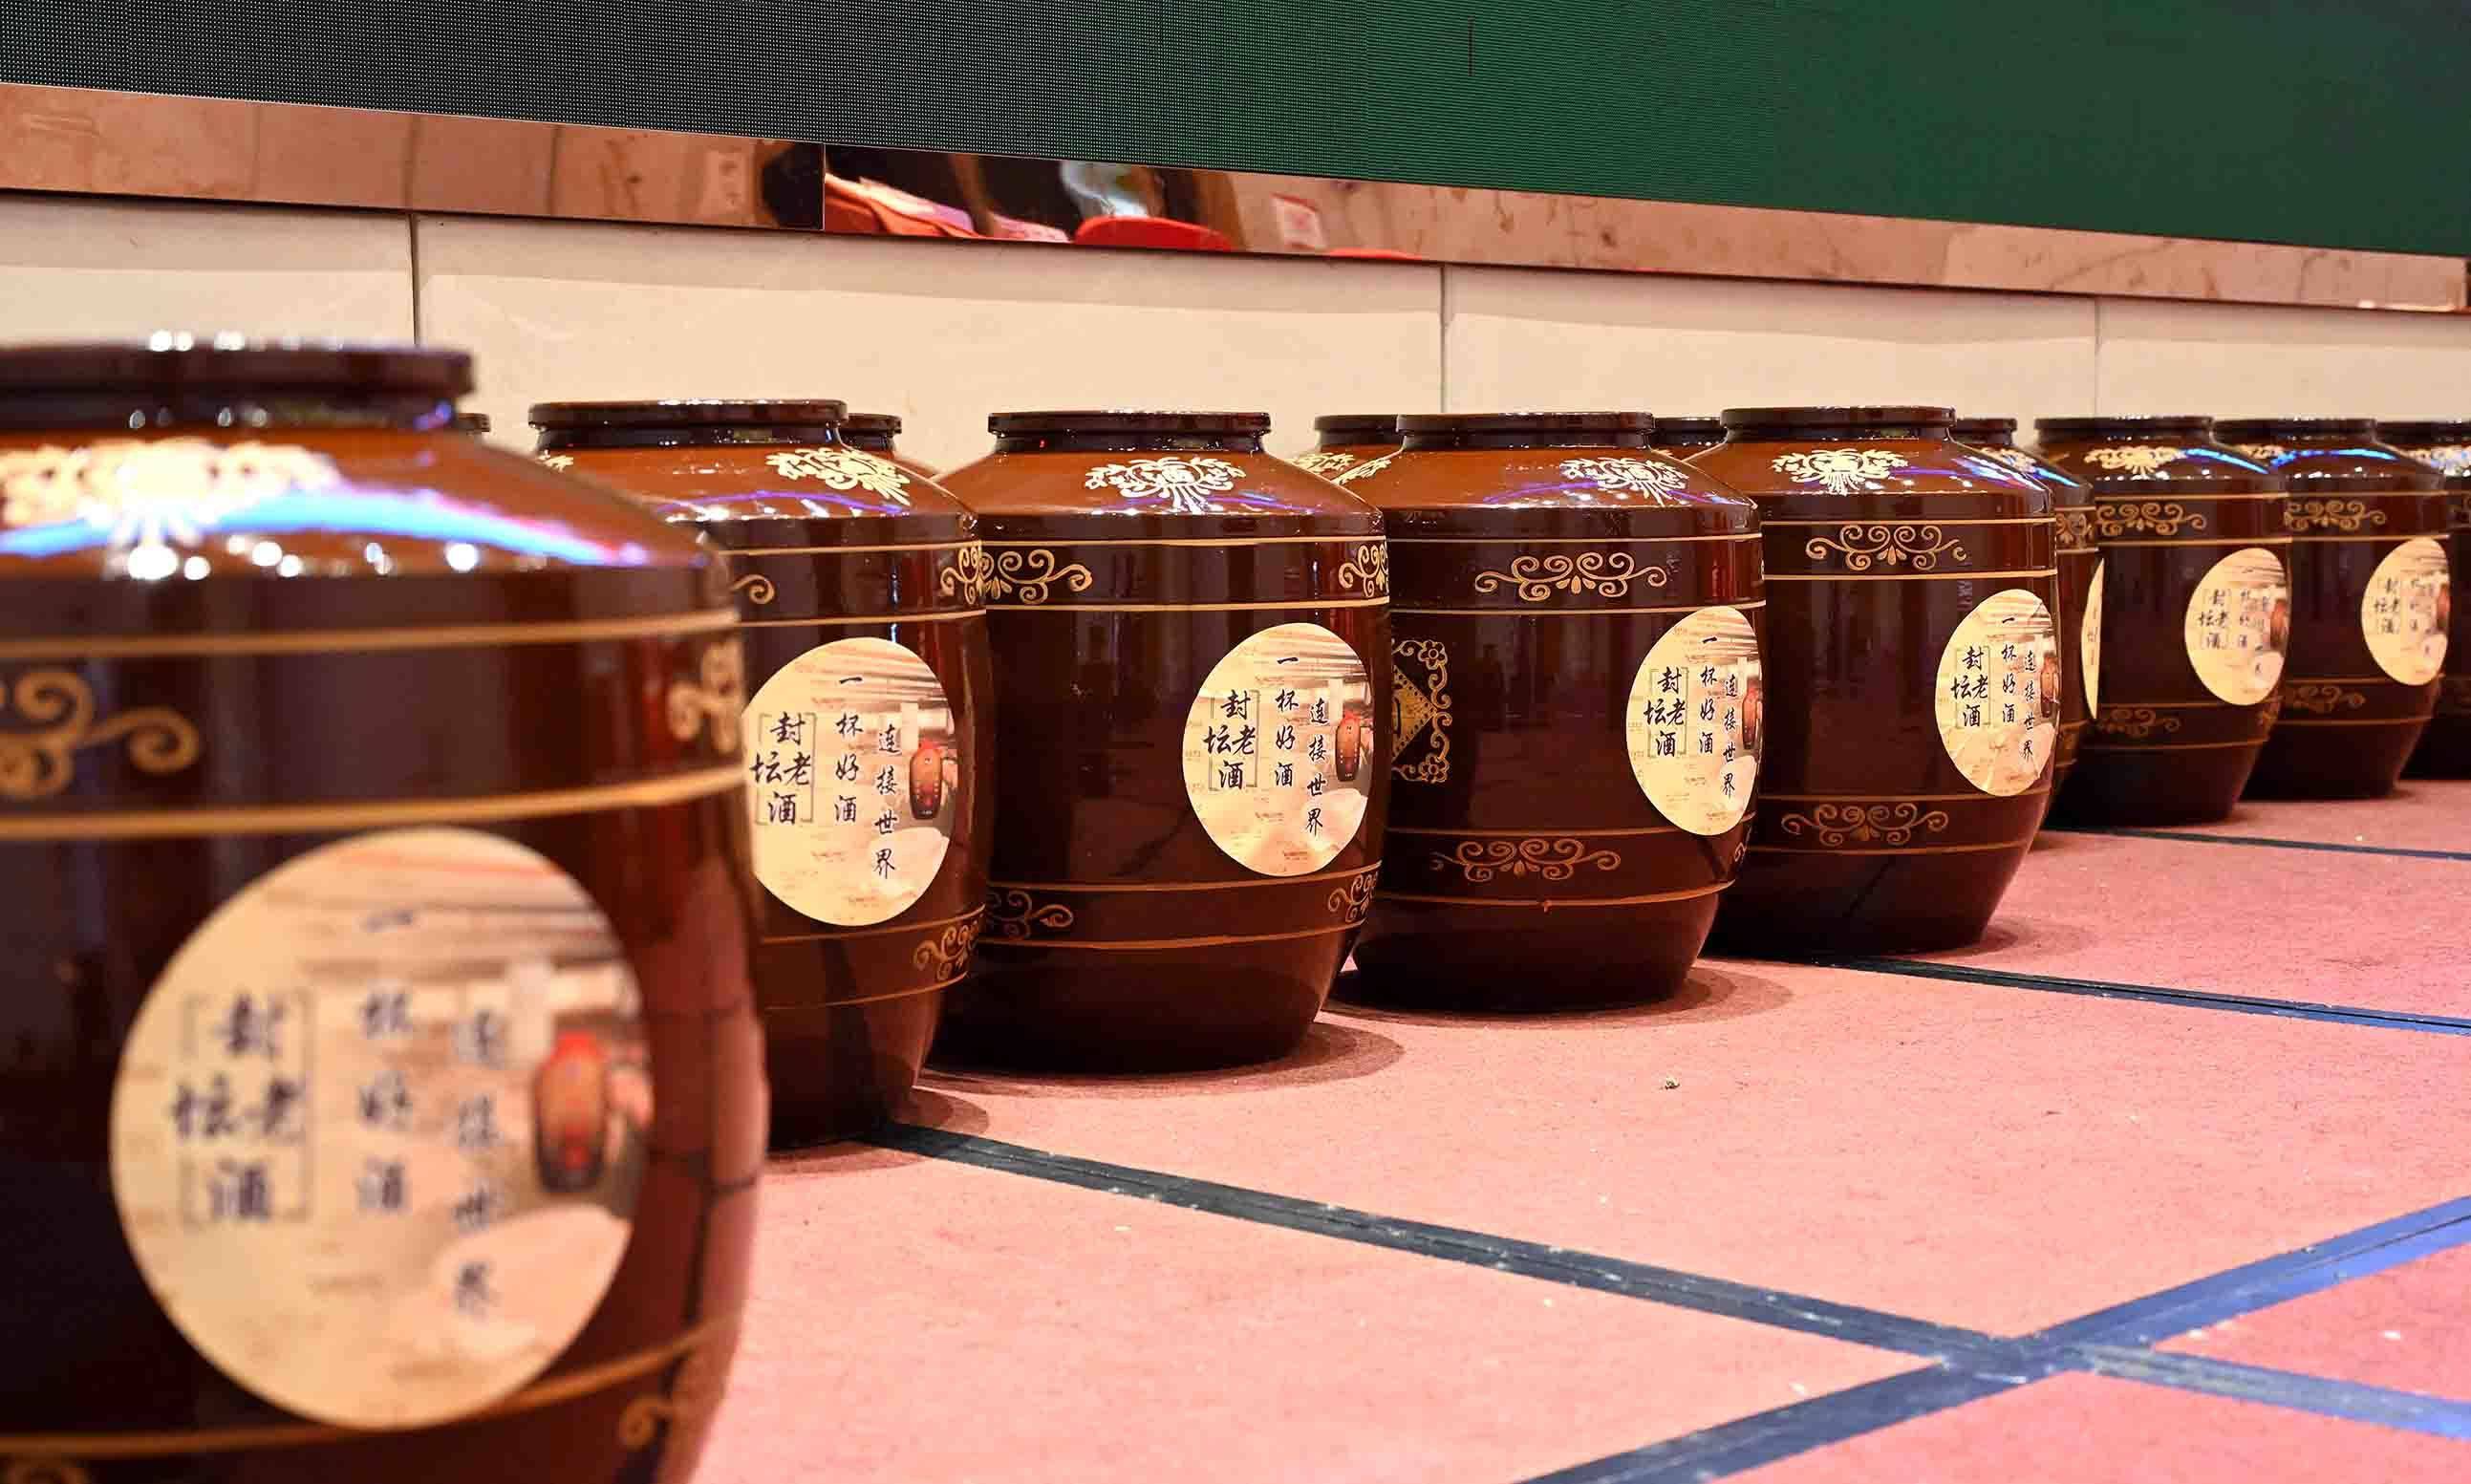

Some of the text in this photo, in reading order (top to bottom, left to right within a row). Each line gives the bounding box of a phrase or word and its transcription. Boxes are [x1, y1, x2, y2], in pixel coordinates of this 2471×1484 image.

[1275, 656, 1300, 787] 一杯好酒
[1643, 666, 1687, 758] 封坛老酒
[1699, 636, 1718, 755] 一杯好酒
[2001, 616, 2017, 723] 一杯好酒
[749, 712, 811, 825] 封坛老酒
[834, 676, 864, 823] 一杯好酒
[1202, 689, 1256, 790] 封坛老酒
[1305, 698, 1328, 836] 连接世界
[1722, 674, 1739, 799] 连接世界
[873, 724, 902, 879] 连接世界
